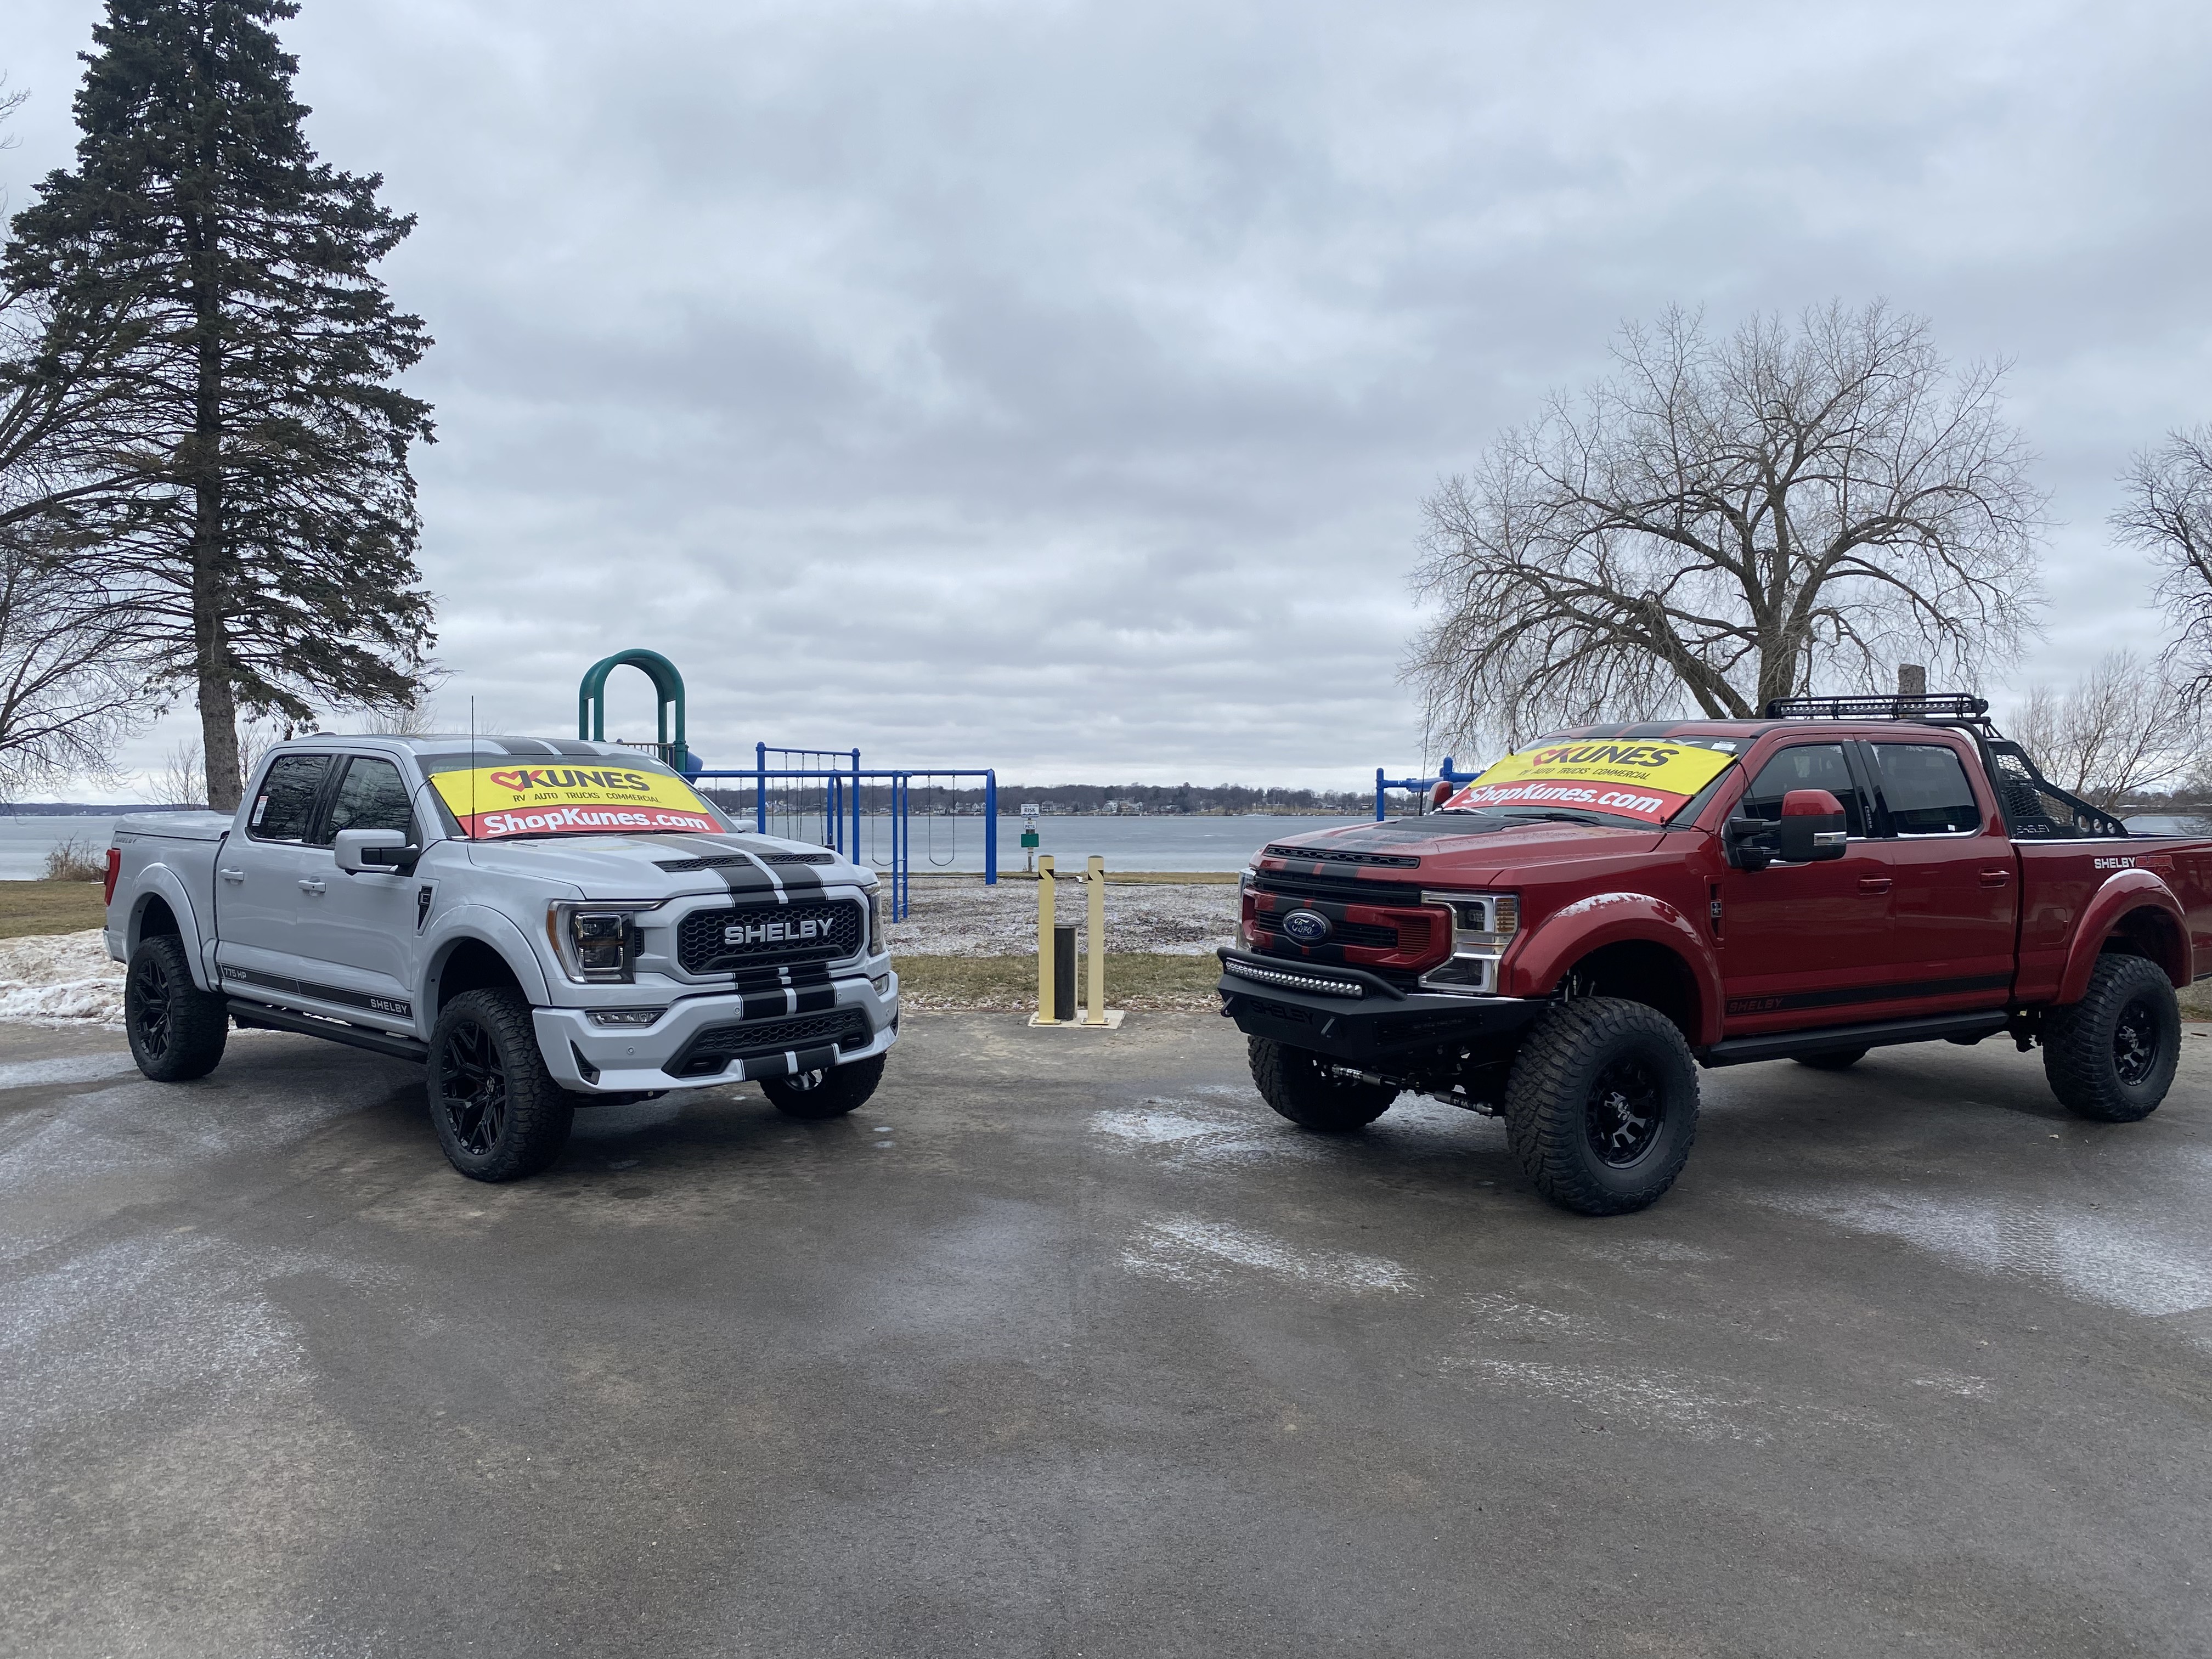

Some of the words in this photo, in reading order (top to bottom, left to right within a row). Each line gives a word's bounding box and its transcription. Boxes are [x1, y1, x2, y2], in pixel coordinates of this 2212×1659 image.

[1543, 746, 1680, 767] KUNES
[518, 770, 650, 791] KUNES
[1592, 768, 1651, 780] COMMERCIAL
[606, 792, 662, 803] COMMERCIAL
[1462, 783, 1664, 813] ShopKunes.com
[483, 808, 710, 834] ShopKunes.com
[2094, 857, 2136, 869] SHELBY
[724, 918, 834, 945] SHELBY
[1292, 917, 1315, 935] Ford
[223, 967, 237, 978] 775
[238, 970, 247, 979] HP
[370, 998, 408, 1014] SHELBY
[1729, 998, 1783, 1012] SHELBY
